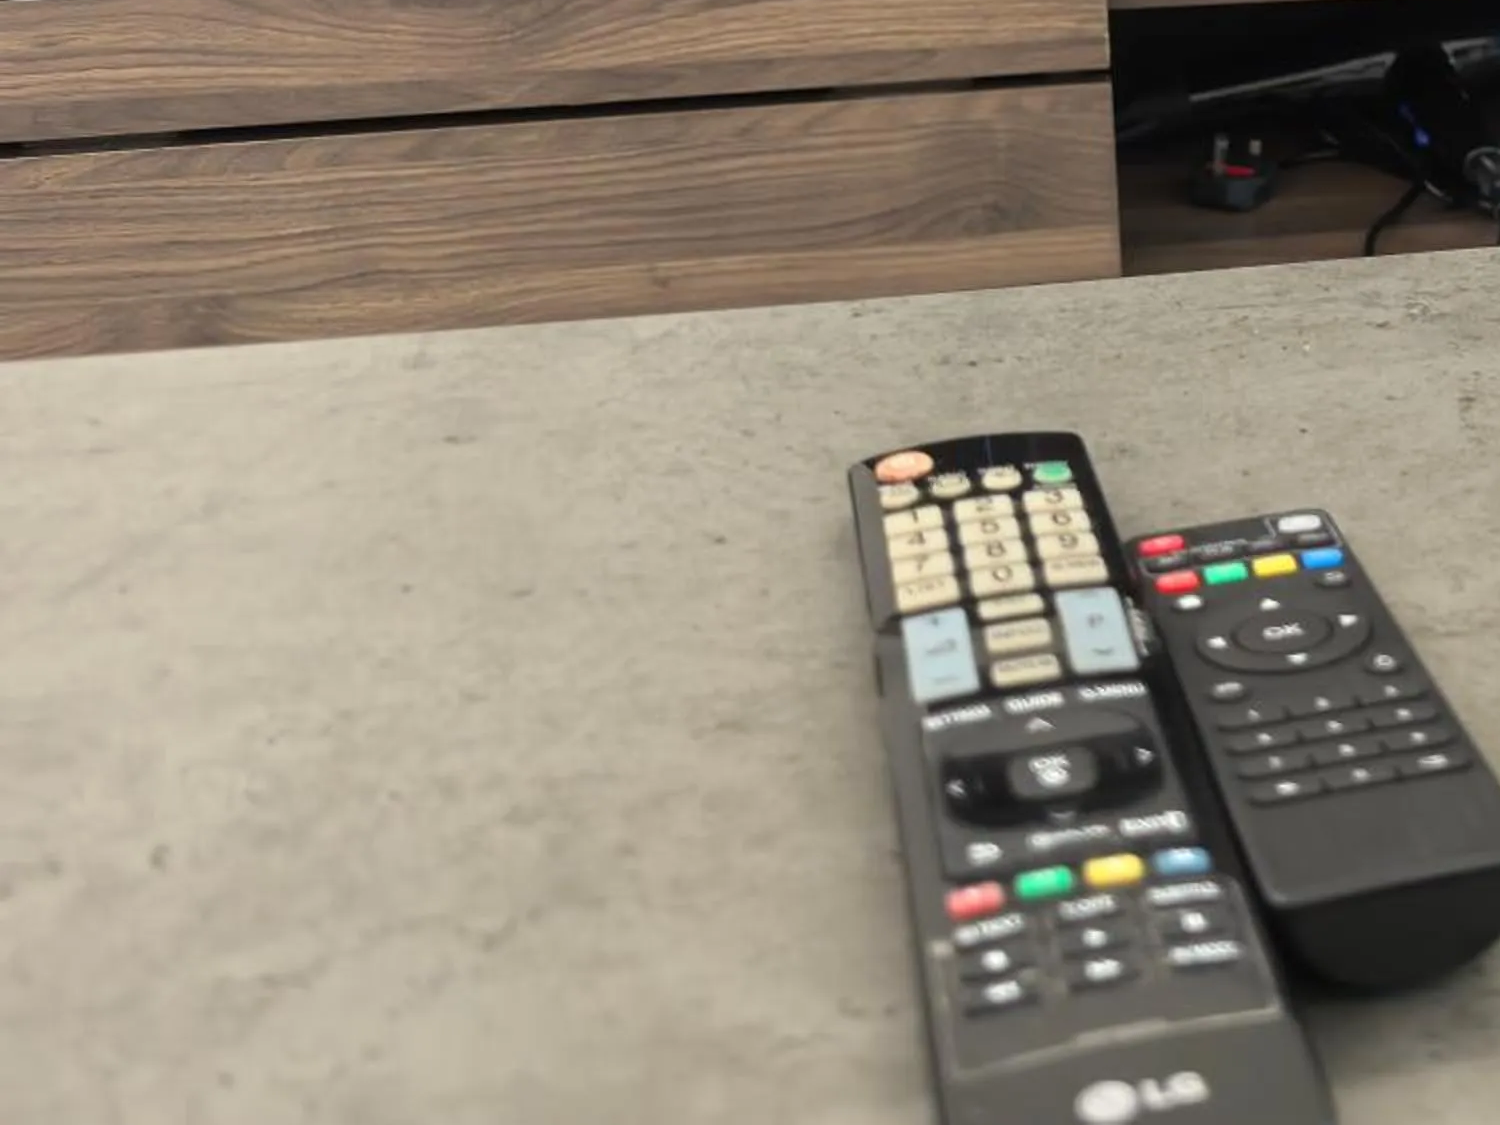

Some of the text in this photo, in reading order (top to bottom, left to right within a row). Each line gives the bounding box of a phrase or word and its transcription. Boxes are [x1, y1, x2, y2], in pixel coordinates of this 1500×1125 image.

[1044, 490, 1063, 504] 3
[1052, 511, 1072, 525] 6
[980, 520, 1000, 534] 5
[907, 531, 926, 546] 4
[1058, 534, 1079, 549] 9
[986, 542, 1006, 558] 8
[1263, 622, 1305, 641] OK
[1138, 1071, 1209, 1111] LG
